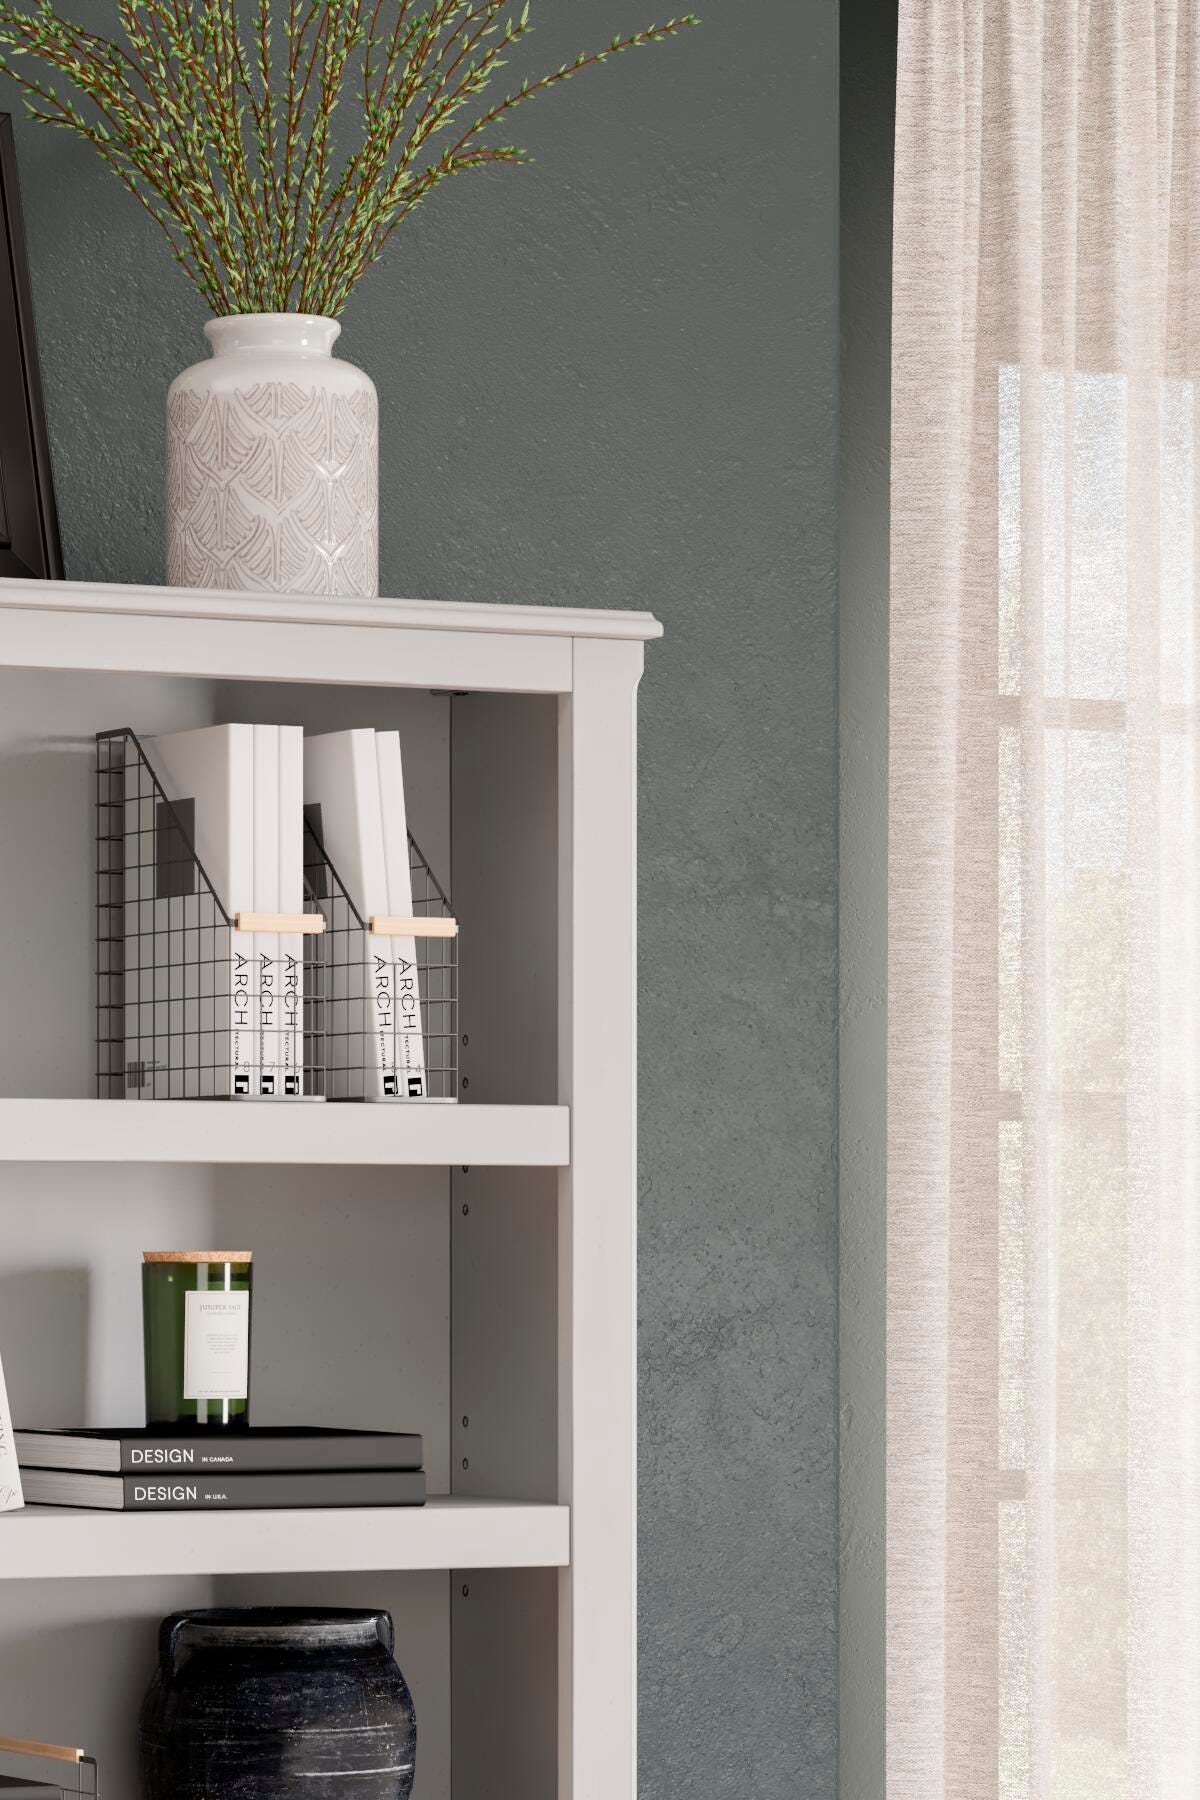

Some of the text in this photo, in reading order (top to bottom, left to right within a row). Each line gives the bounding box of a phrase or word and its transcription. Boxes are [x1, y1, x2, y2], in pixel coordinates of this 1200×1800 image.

[235, 952, 248, 1025] ARCH
[259, 953, 273, 1025] ARCH
[284, 953, 298, 1026] ARCH
[374, 955, 392, 1027] ARCH
[398, 957, 416, 1029] ARCH
[131, 1448, 194, 1464] DESIGN
[134, 1486, 197, 1501] DESIGN
